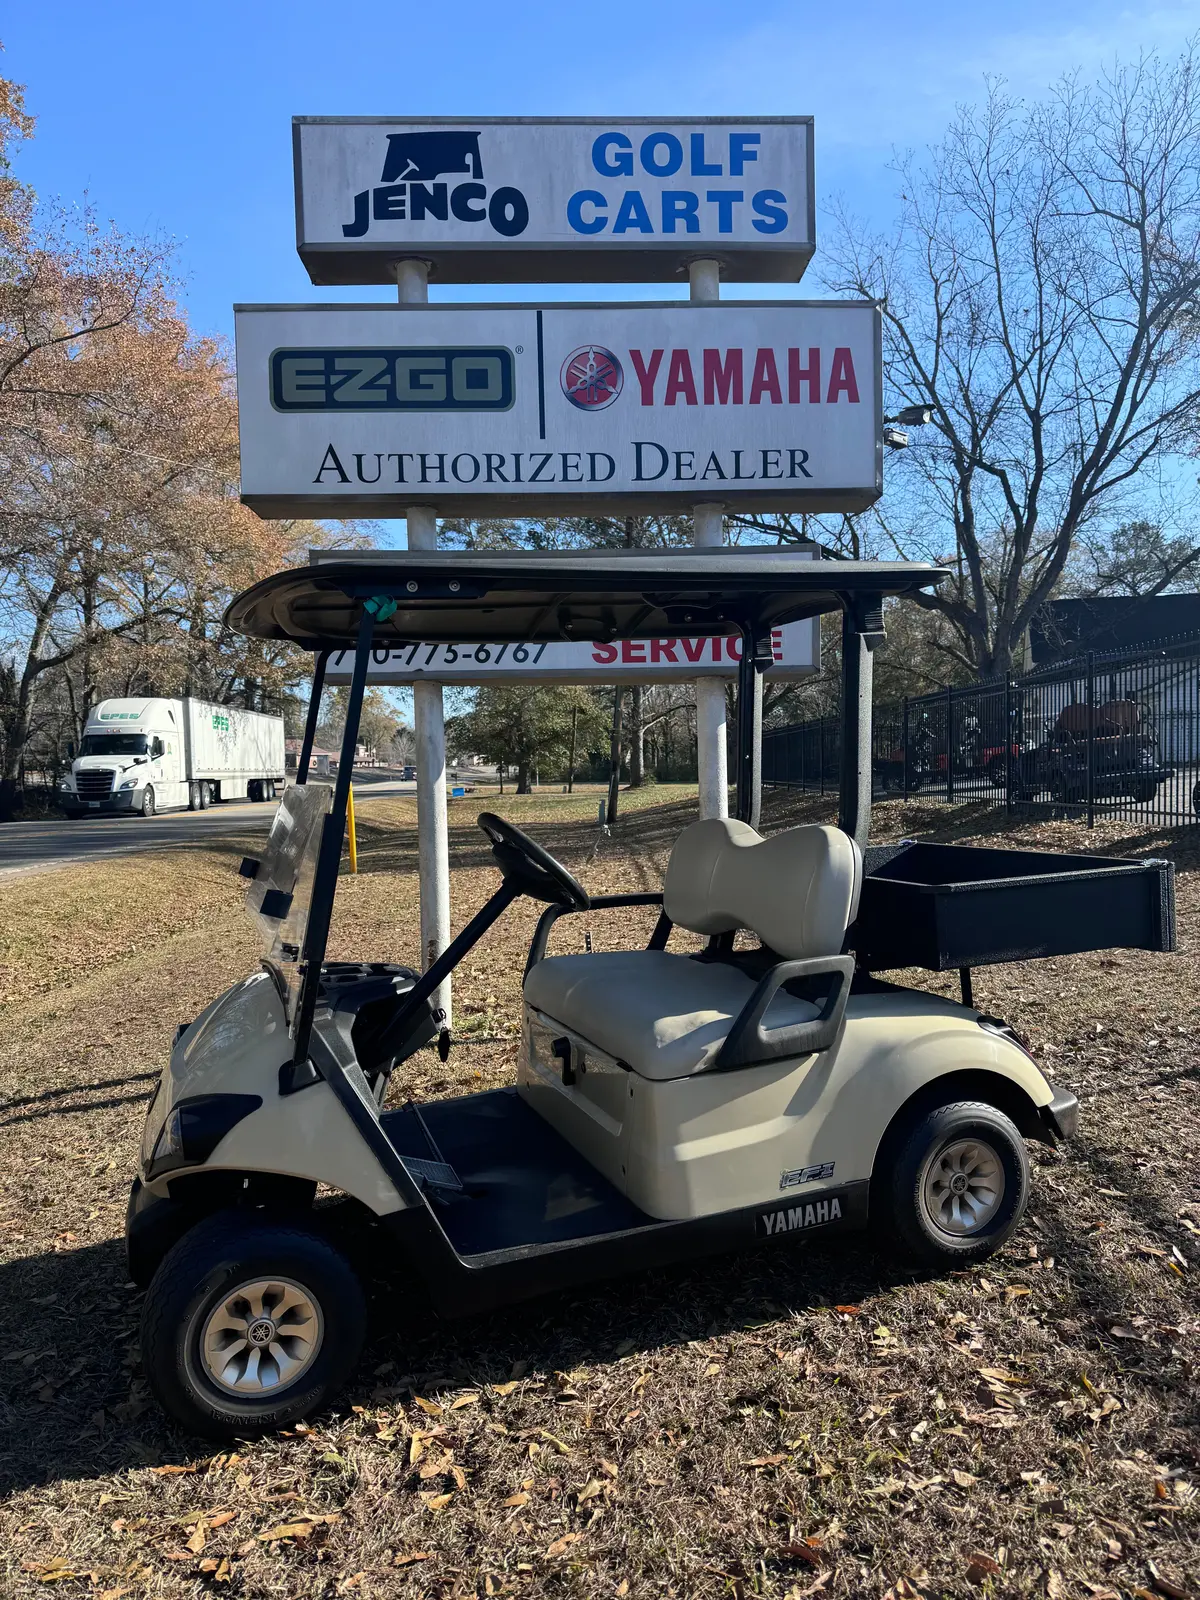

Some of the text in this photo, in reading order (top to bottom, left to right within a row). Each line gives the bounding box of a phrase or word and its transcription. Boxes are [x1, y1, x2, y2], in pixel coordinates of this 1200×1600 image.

[591, 131, 761, 178] GOLF
[341, 182, 529, 238] JENCO
[566, 189, 789, 235] CARTS
[628, 347, 861, 406] YAMAHA
[312, 441, 813, 484] AUTHORIZED DEALER
[334, 642, 548, 666] 70-775-6767
[762, 1198, 842, 1235] YAMAHA
